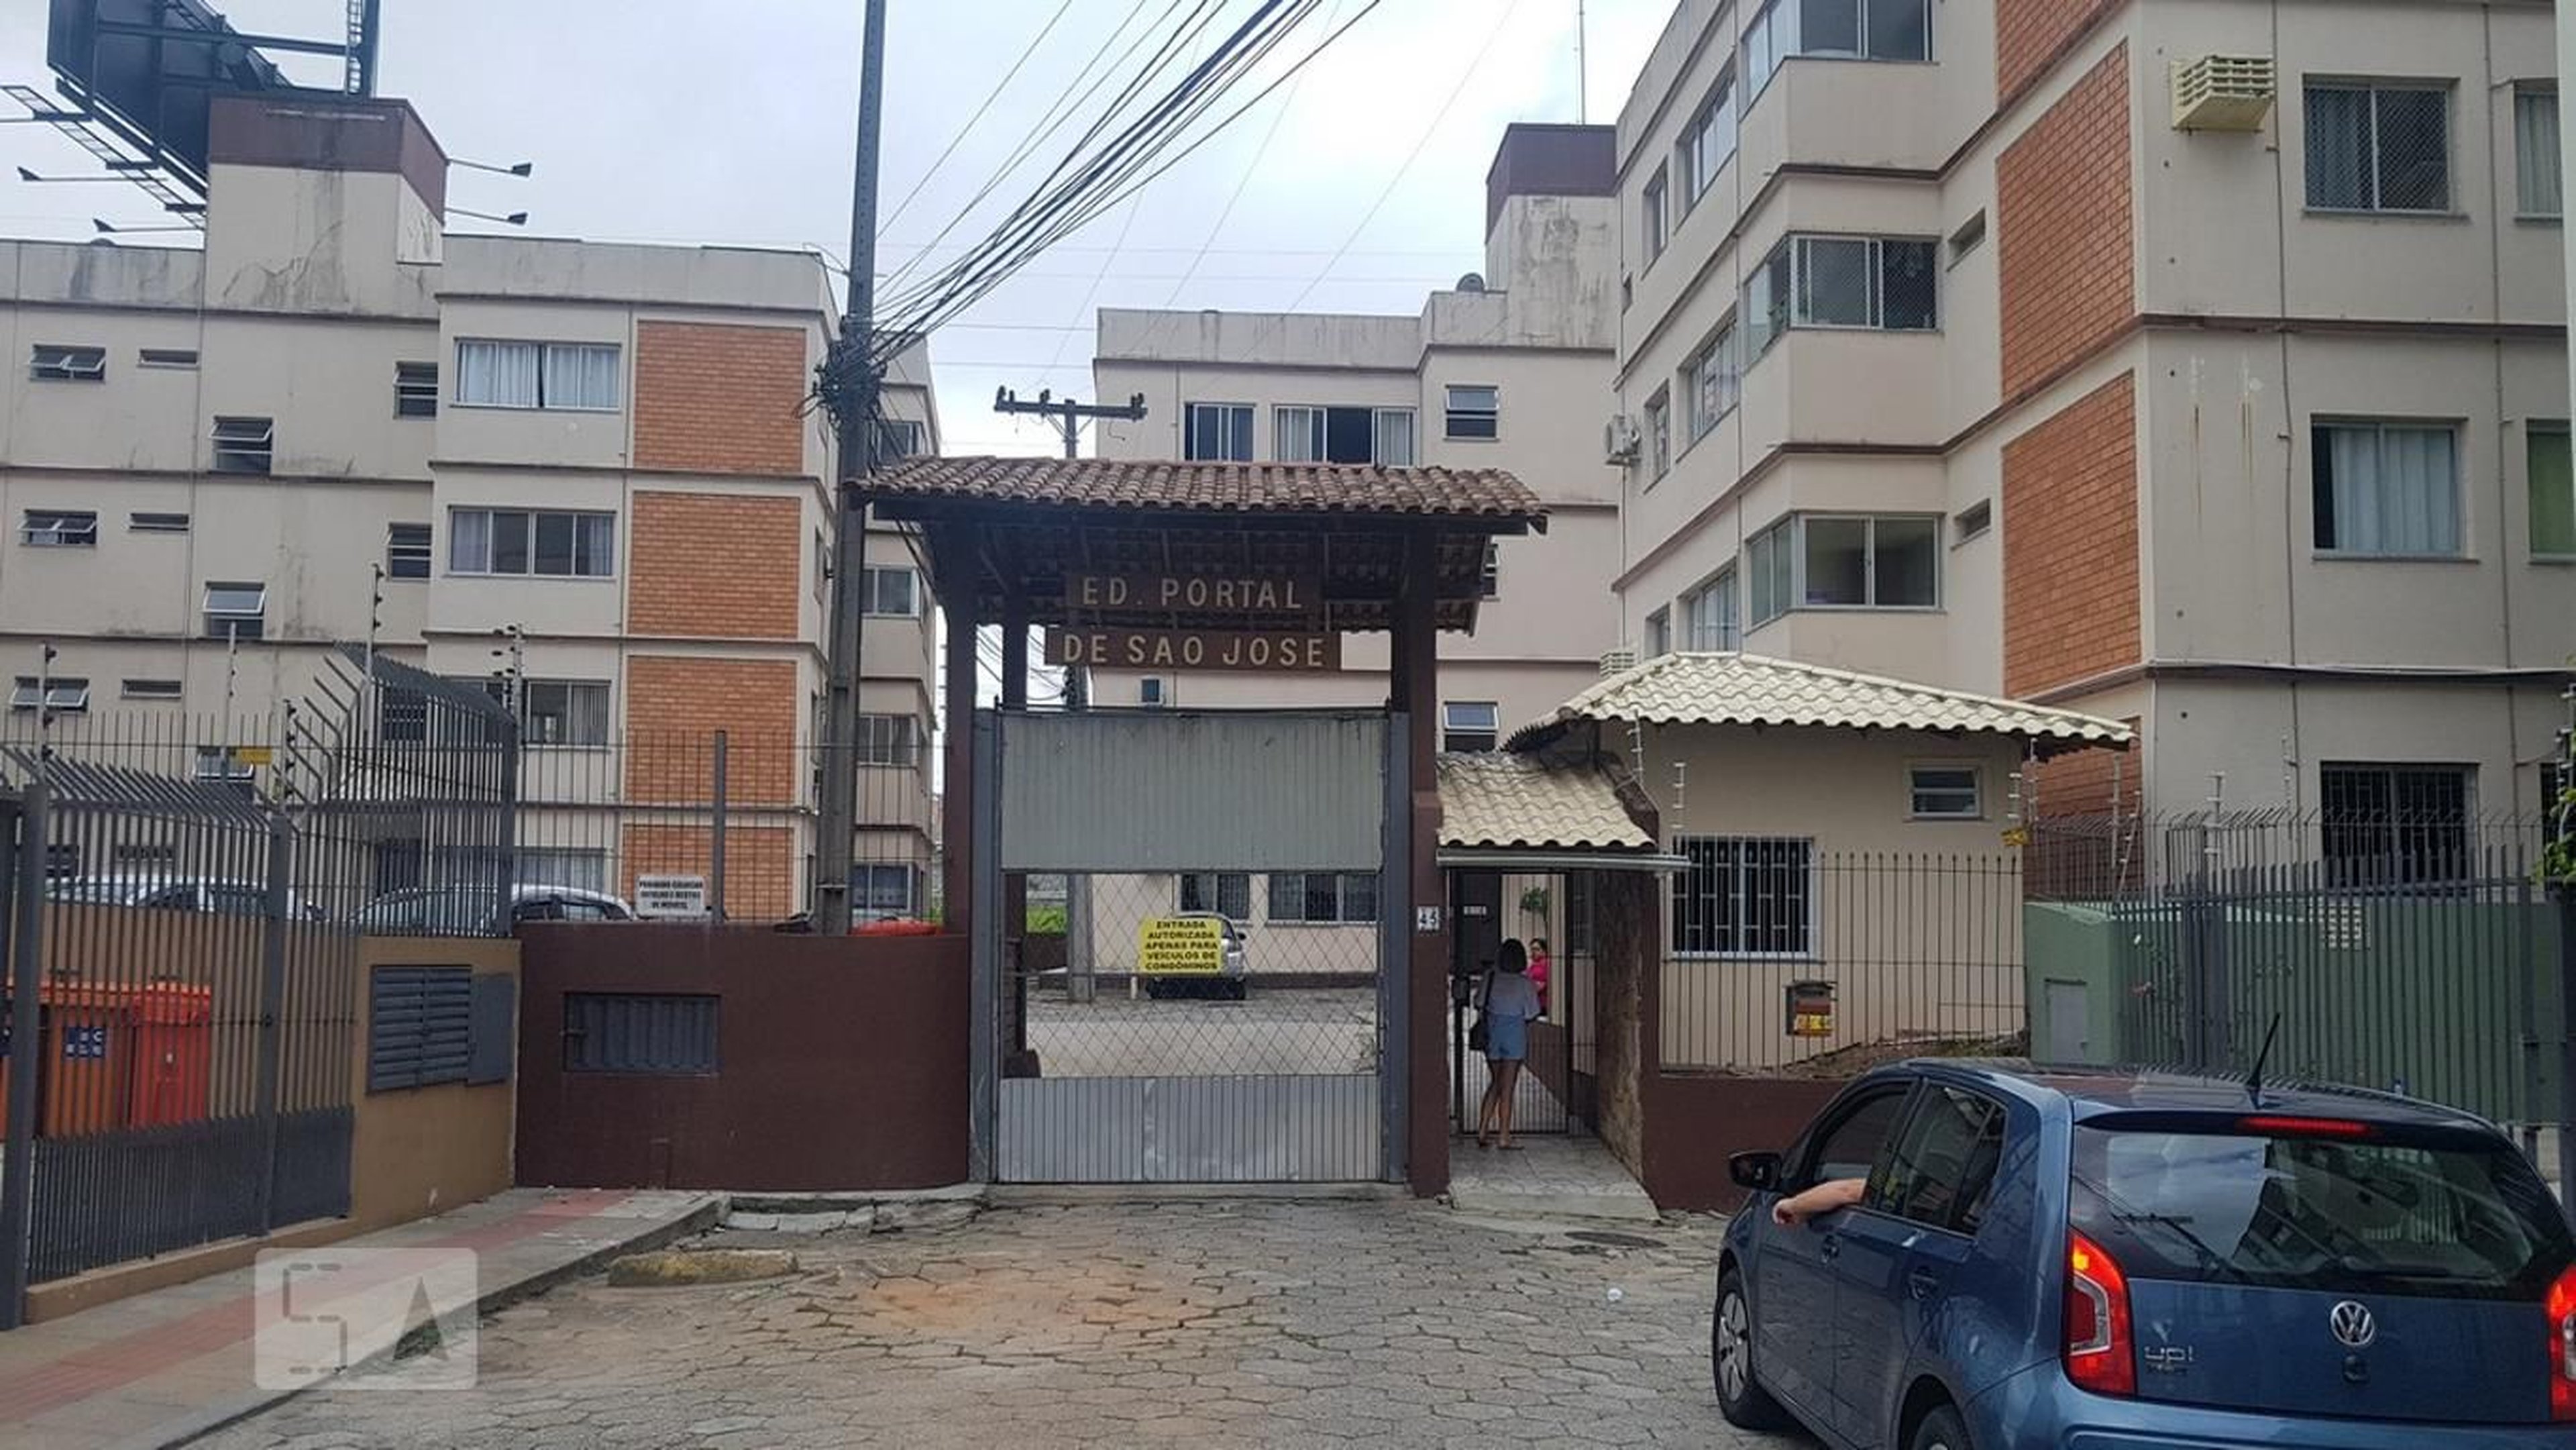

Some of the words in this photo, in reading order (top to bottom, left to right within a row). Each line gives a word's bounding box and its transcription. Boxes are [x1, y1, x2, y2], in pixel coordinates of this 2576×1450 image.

[1083, 577, 1142, 605] ED.
[1161, 578, 1301, 609] PORTAL
[1064, 635, 1107, 662] DE
[1127, 635, 1203, 664] SAO
[1223, 637, 1323, 666] JOSE
[1157, 921, 1206, 929] ENTRADA
[1145, 941, 1187, 949] APENAS
[1190, 941, 1218, 949] PARA
[1202, 951, 1216, 960] DE
